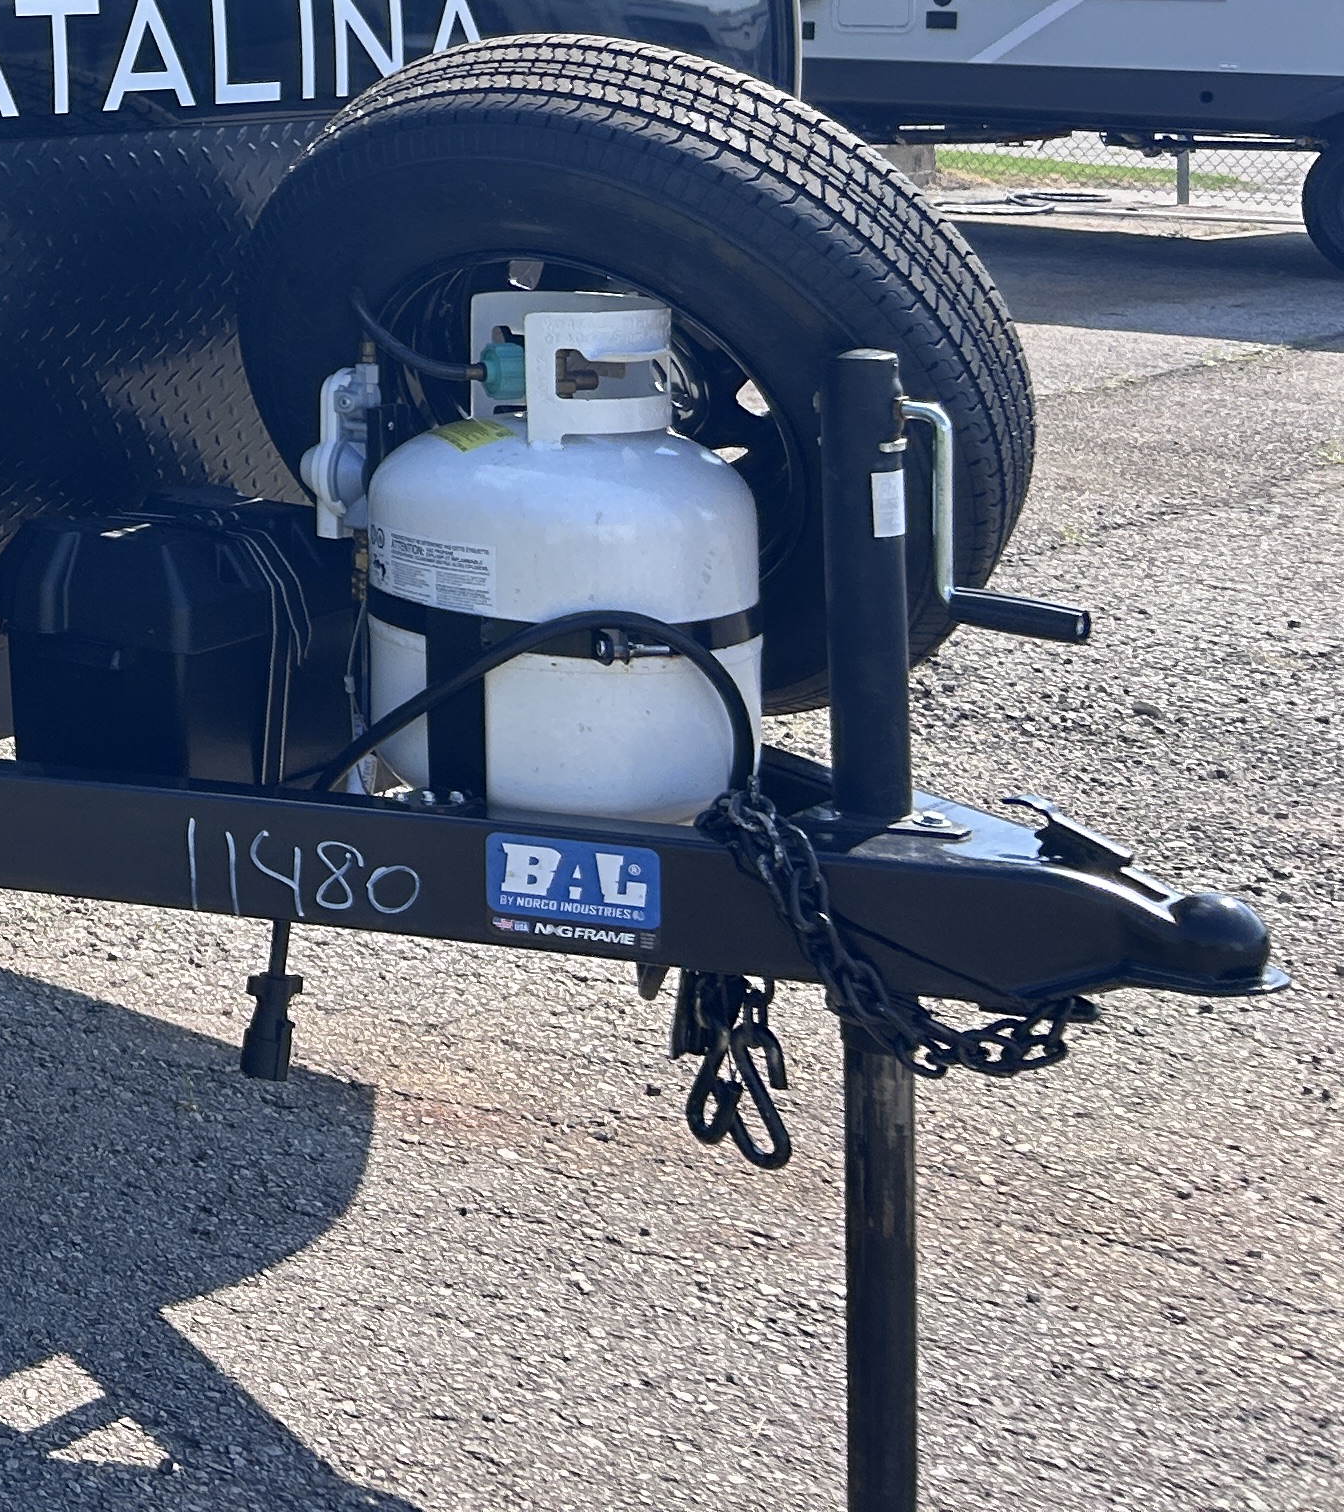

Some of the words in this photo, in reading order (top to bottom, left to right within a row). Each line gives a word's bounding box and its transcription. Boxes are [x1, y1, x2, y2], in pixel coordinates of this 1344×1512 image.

[187, 817, 420, 917] 11480
[499, 894, 514, 906] BY
[516, 896, 558, 912] NORCO
[559, 901, 632, 921] INDUSTRIES
